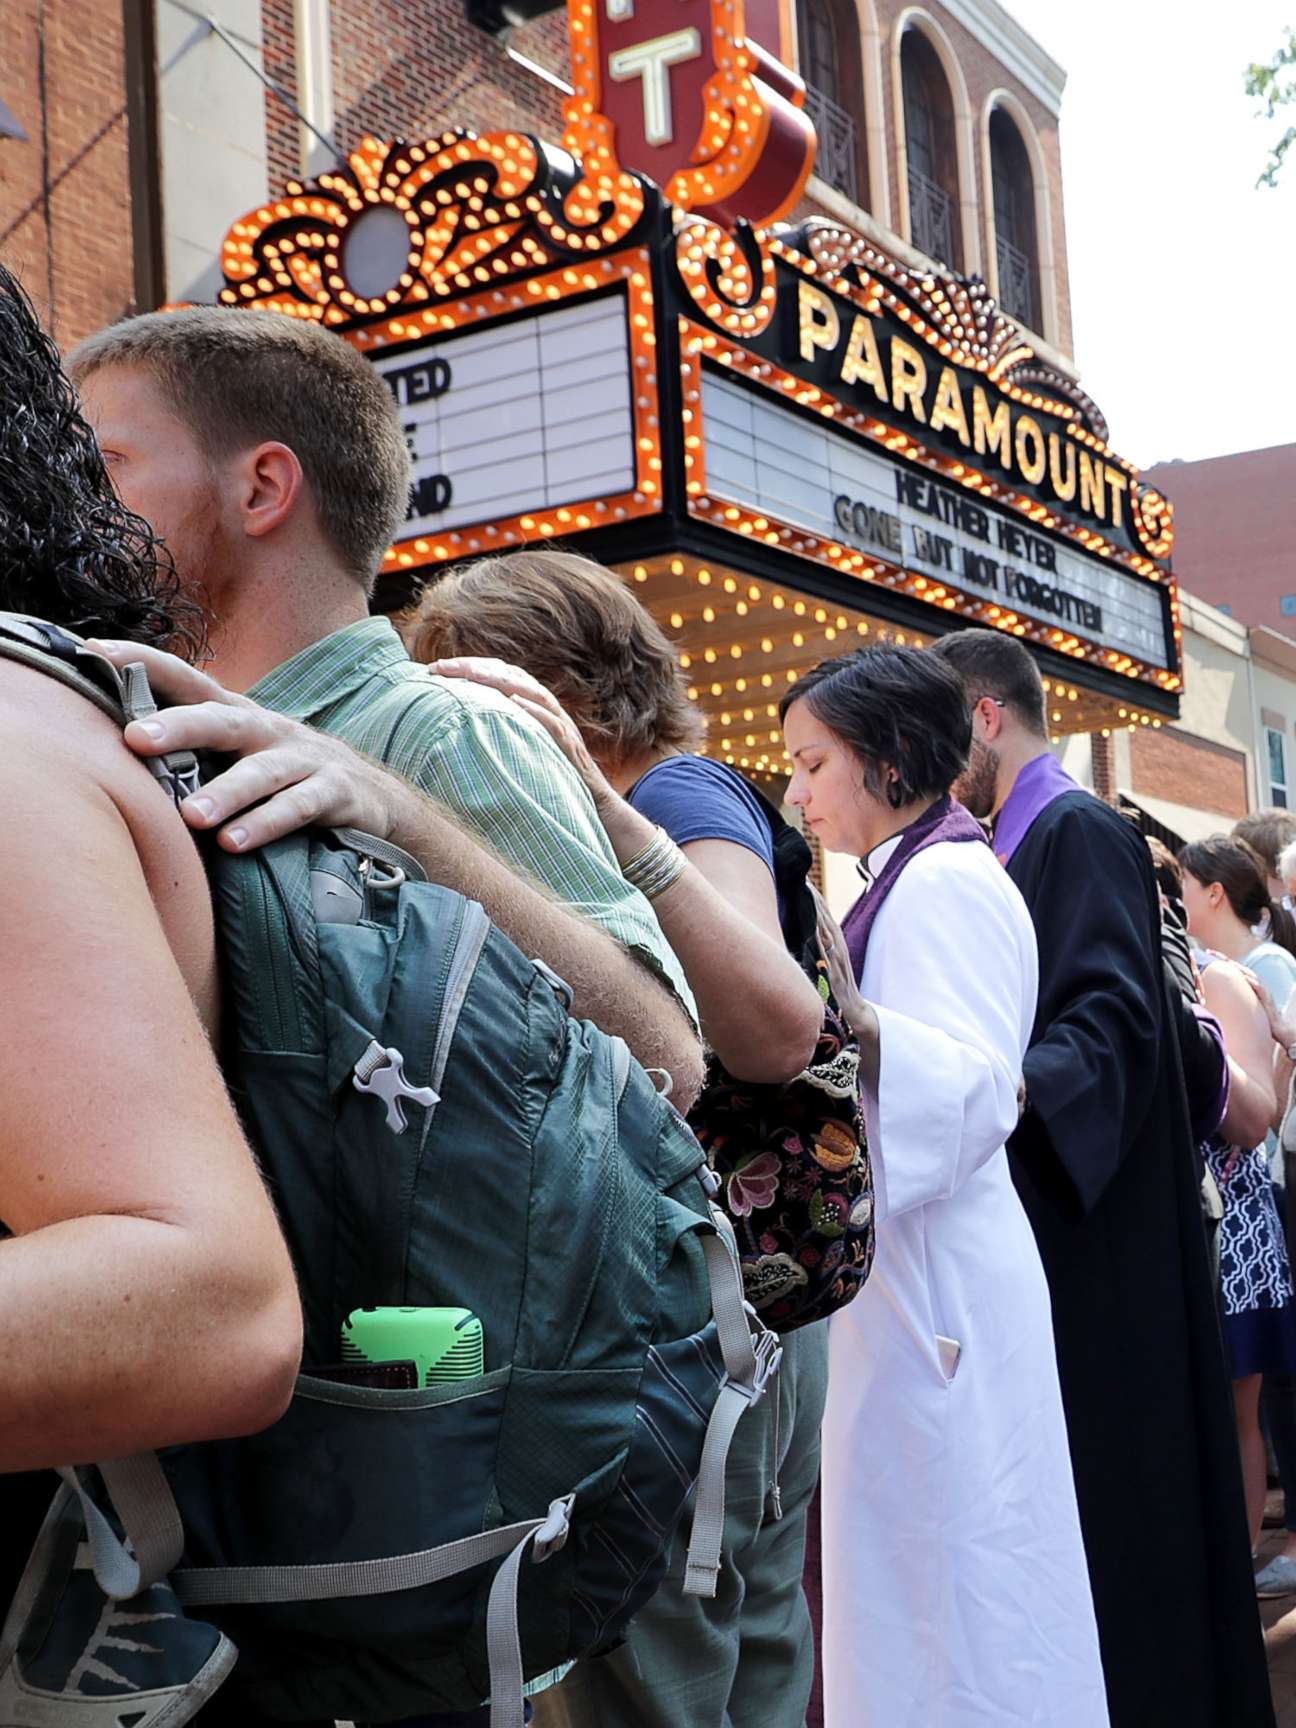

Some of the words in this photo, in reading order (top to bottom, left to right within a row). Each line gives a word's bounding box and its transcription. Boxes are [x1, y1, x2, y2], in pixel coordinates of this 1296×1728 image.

[607, 0, 702, 147] T
[798, 279, 1127, 528] PARAMOUNT
[834, 494, 902, 554] GONE
[912, 524, 953, 572] BUT
[963, 547, 999, 590] NOT
[1004, 565, 1103, 634] FORGOTTEN
[894, 468, 991, 544] HEATHER
[997, 519, 1058, 575] HEYER
